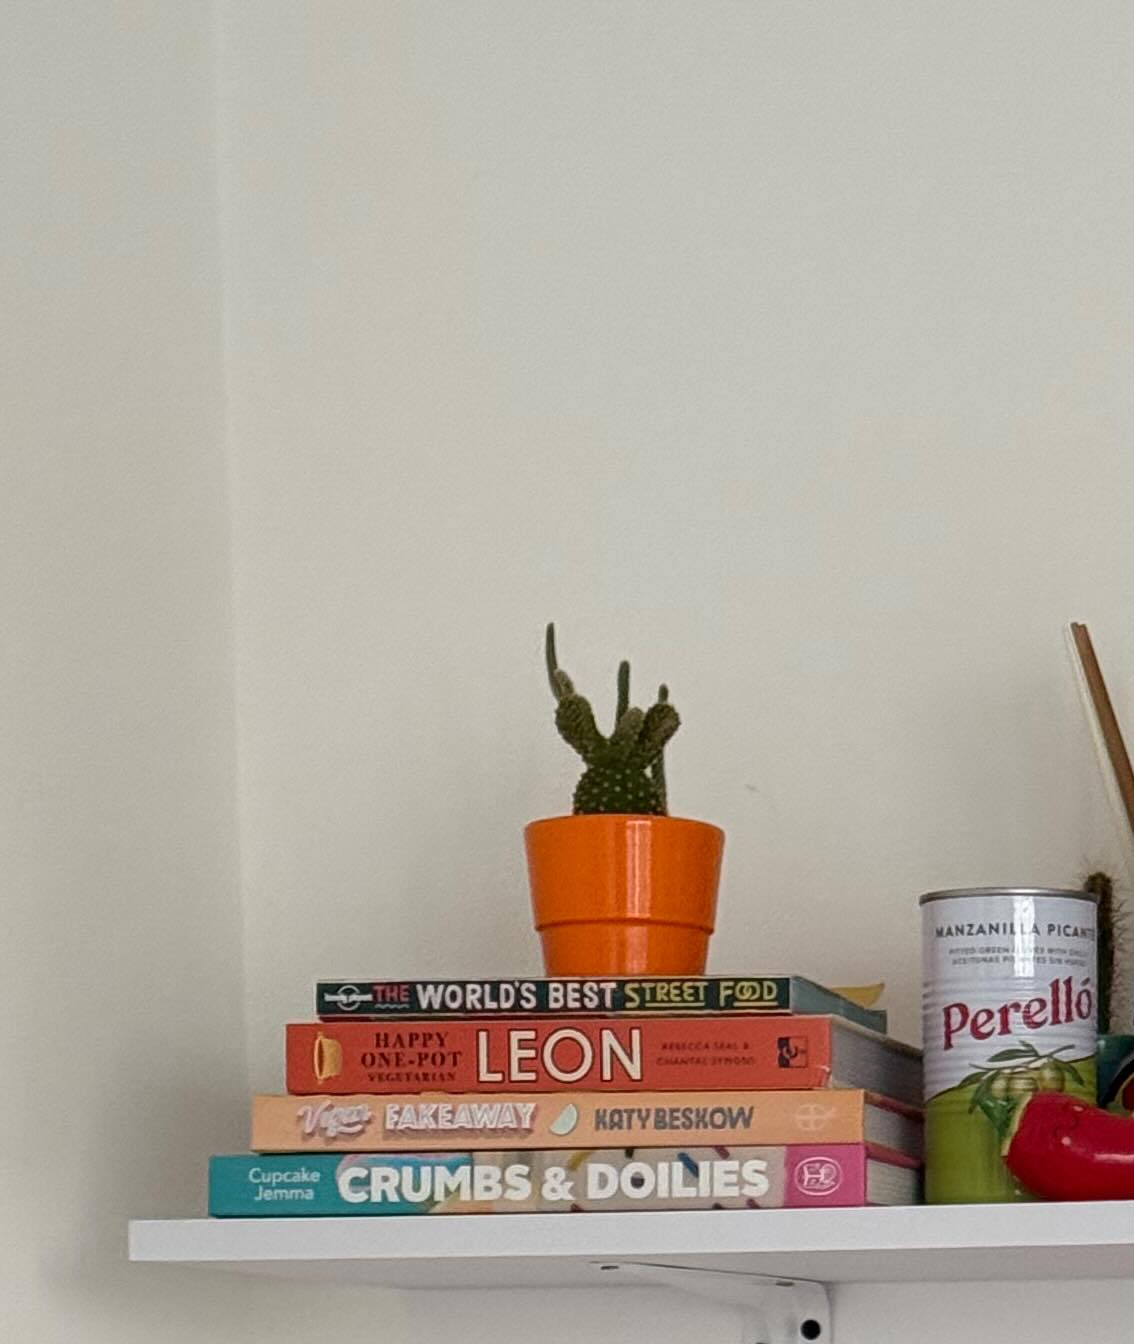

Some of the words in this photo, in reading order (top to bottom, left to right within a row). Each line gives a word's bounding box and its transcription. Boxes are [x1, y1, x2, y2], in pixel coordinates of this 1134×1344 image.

[373, 984, 410, 1002] THE
[416, 981, 537, 1010] WORLD'S
[549, 983, 617, 1009] BEST
[624, 981, 706, 1007] STREET
[718, 980, 778, 1007] FOOD
[943, 976, 1092, 1051] Perelló
[375, 1031, 449, 1049] HAPPY
[360, 1051, 462, 1069] ONE-POT
[476, 1027, 643, 1083] LEON
[384, 1102, 537, 1131] FAKEAWAY
[594, 1107, 653, 1131] KATY
[653, 1105, 755, 1131] BESKOW
[248, 1167, 321, 1186] Cupcake
[336, 1164, 532, 1204] CRUMBS
[541, 1167, 575, 1202] &
[586, 1159, 769, 1200] DOILIES
[254, 1186, 315, 1202] Jemma
